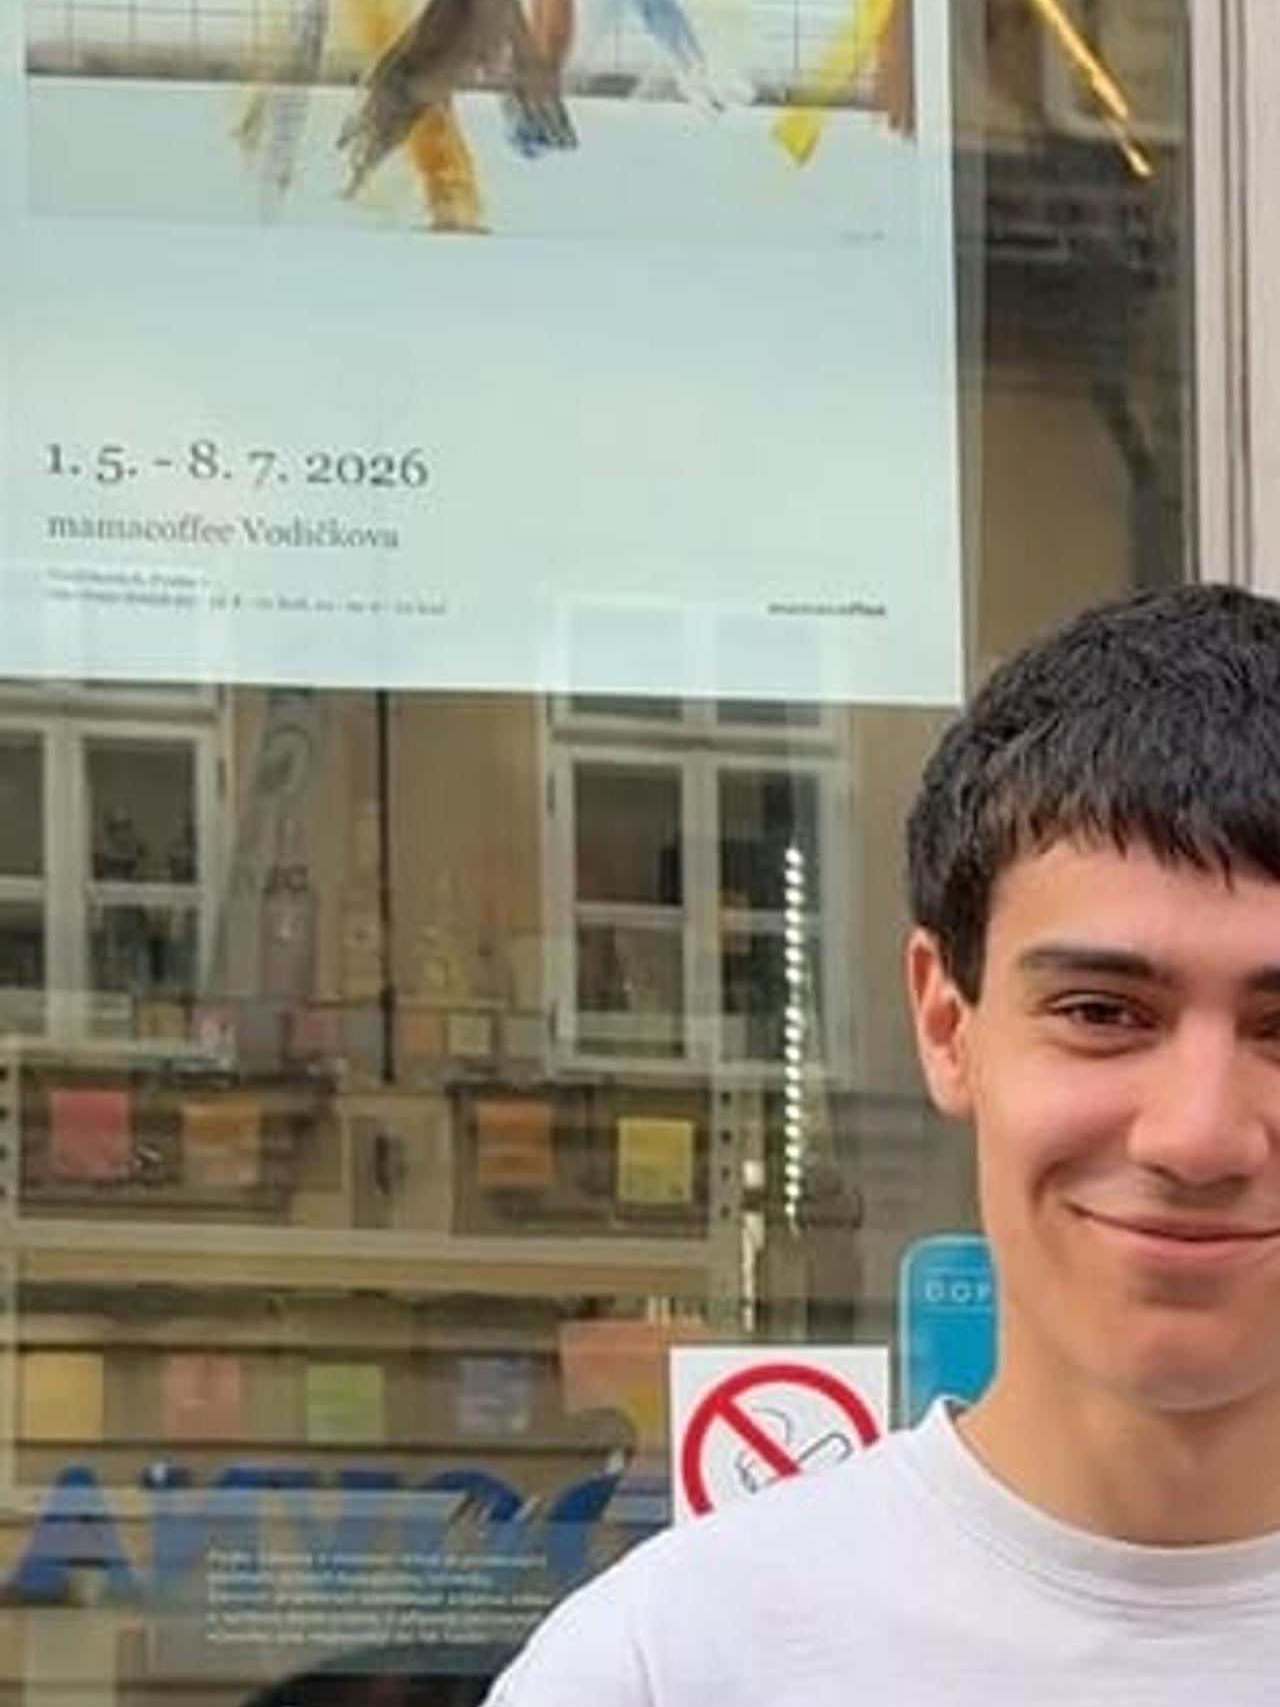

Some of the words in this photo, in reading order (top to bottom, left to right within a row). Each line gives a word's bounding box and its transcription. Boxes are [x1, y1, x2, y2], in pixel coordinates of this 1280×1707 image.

[46, 442, 82, 476] 1.
[96, 445, 138, 484] 5.
[187, 439, 233, 481] 8.
[247, 450, 289, 491] 7.
[304, 447, 430, 488] 2026
[47, 513, 236, 545] mamacoffee
[241, 516, 400, 549] Vodičkova
